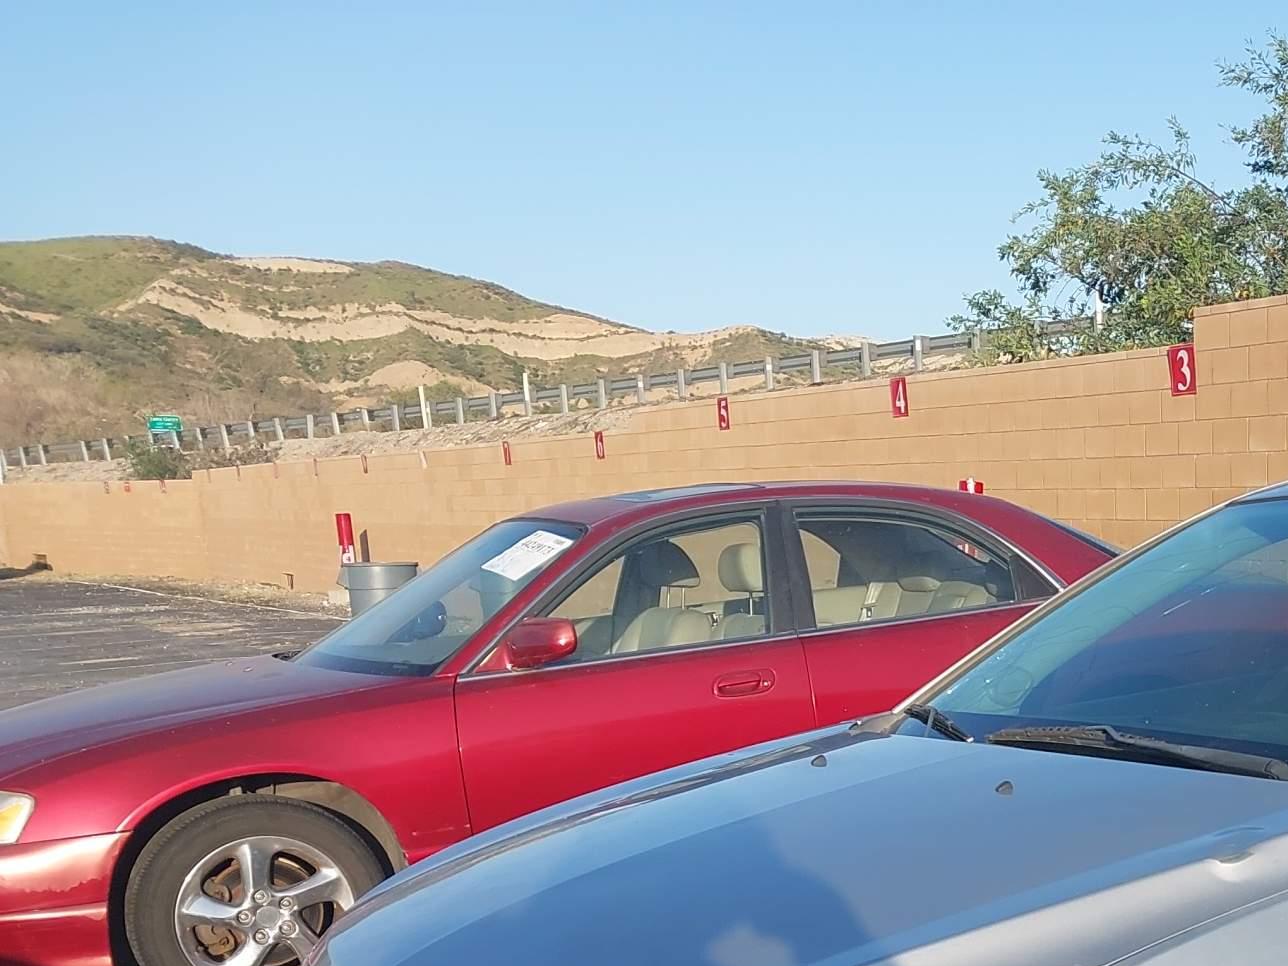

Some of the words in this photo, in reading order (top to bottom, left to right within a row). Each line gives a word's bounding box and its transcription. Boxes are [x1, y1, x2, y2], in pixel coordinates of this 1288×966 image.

[1177, 349, 1191, 391] 3
[895, 380, 905, 414] 4
[720, 400, 727, 428] 5
[597, 432, 604, 458] 6
